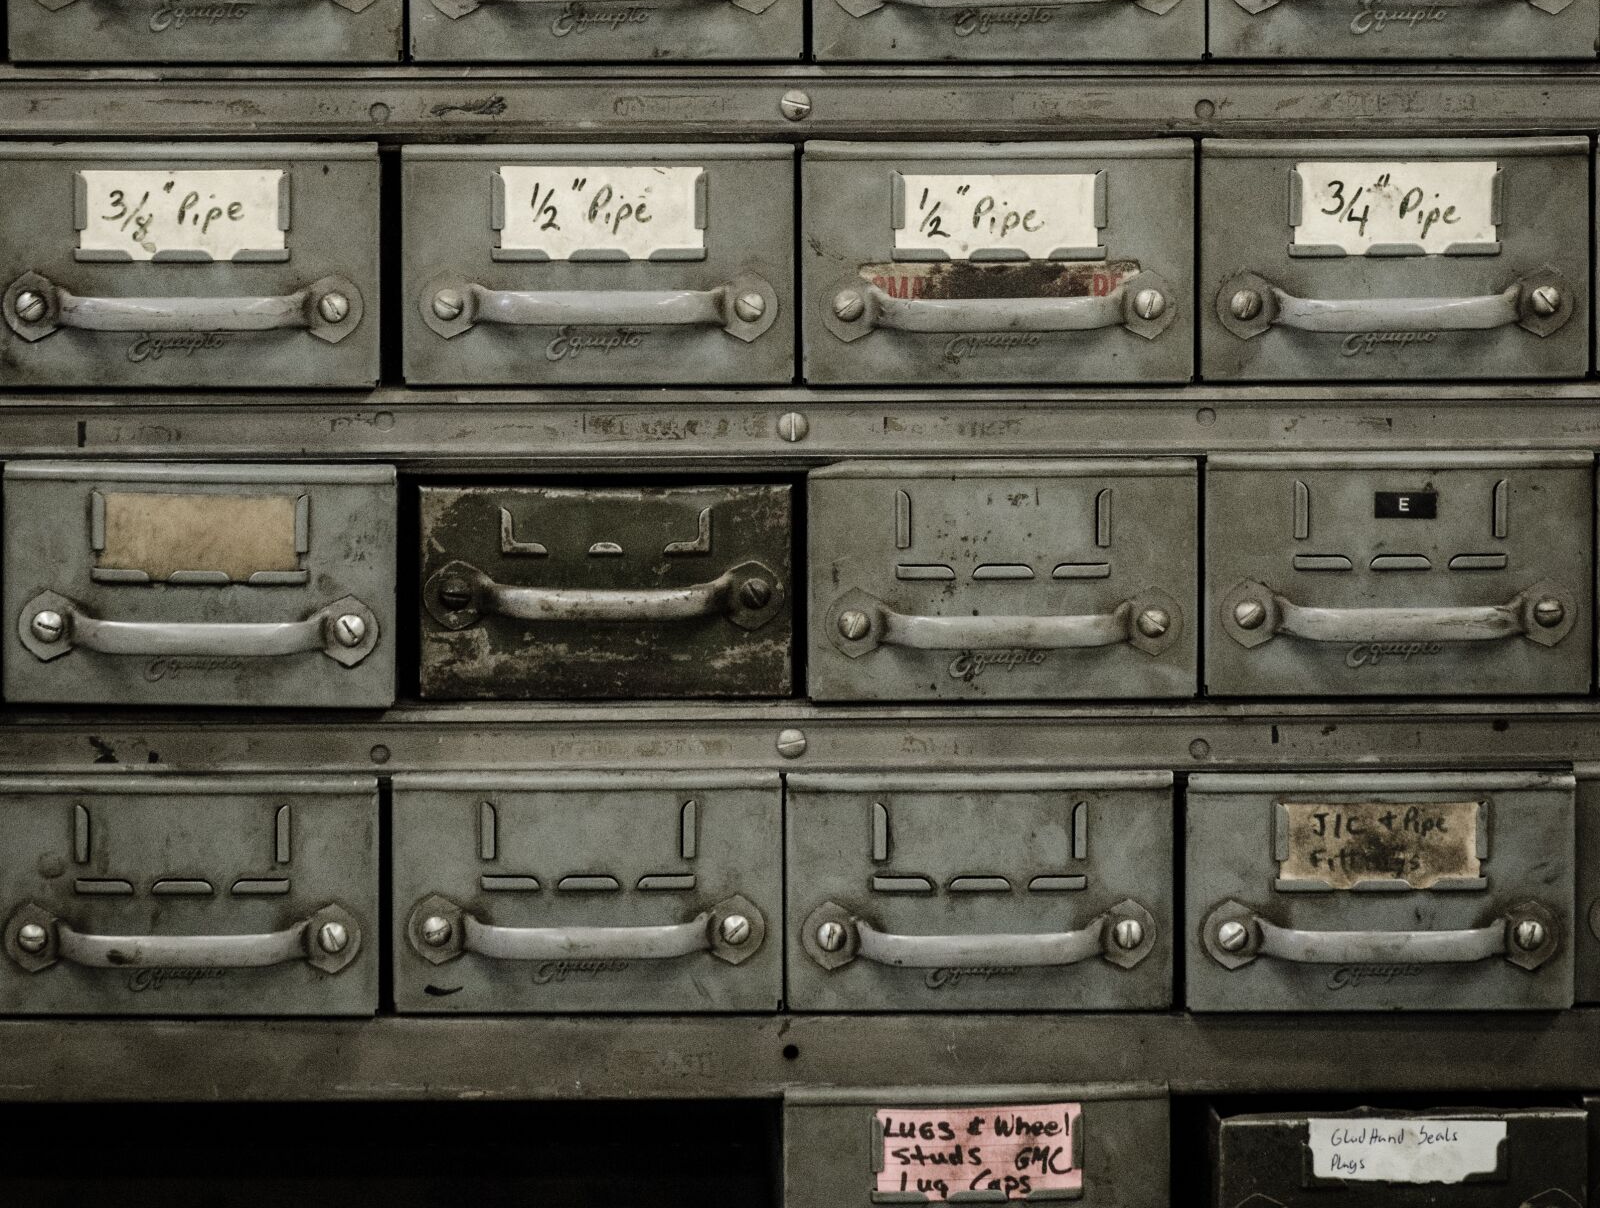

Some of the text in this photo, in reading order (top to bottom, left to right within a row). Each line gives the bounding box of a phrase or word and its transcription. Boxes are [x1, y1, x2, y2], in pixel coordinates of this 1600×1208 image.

[178, 191, 246, 235] Pipe
[587, 184, 653, 235] Pipe
[972, 195, 1045, 238] Pipe
[1399, 187, 1463, 239] Pipe
[1398, 496, 1410, 513] E
[994, 1112, 1070, 1138] Wheel
[1014, 1146, 1073, 1174] GMC
